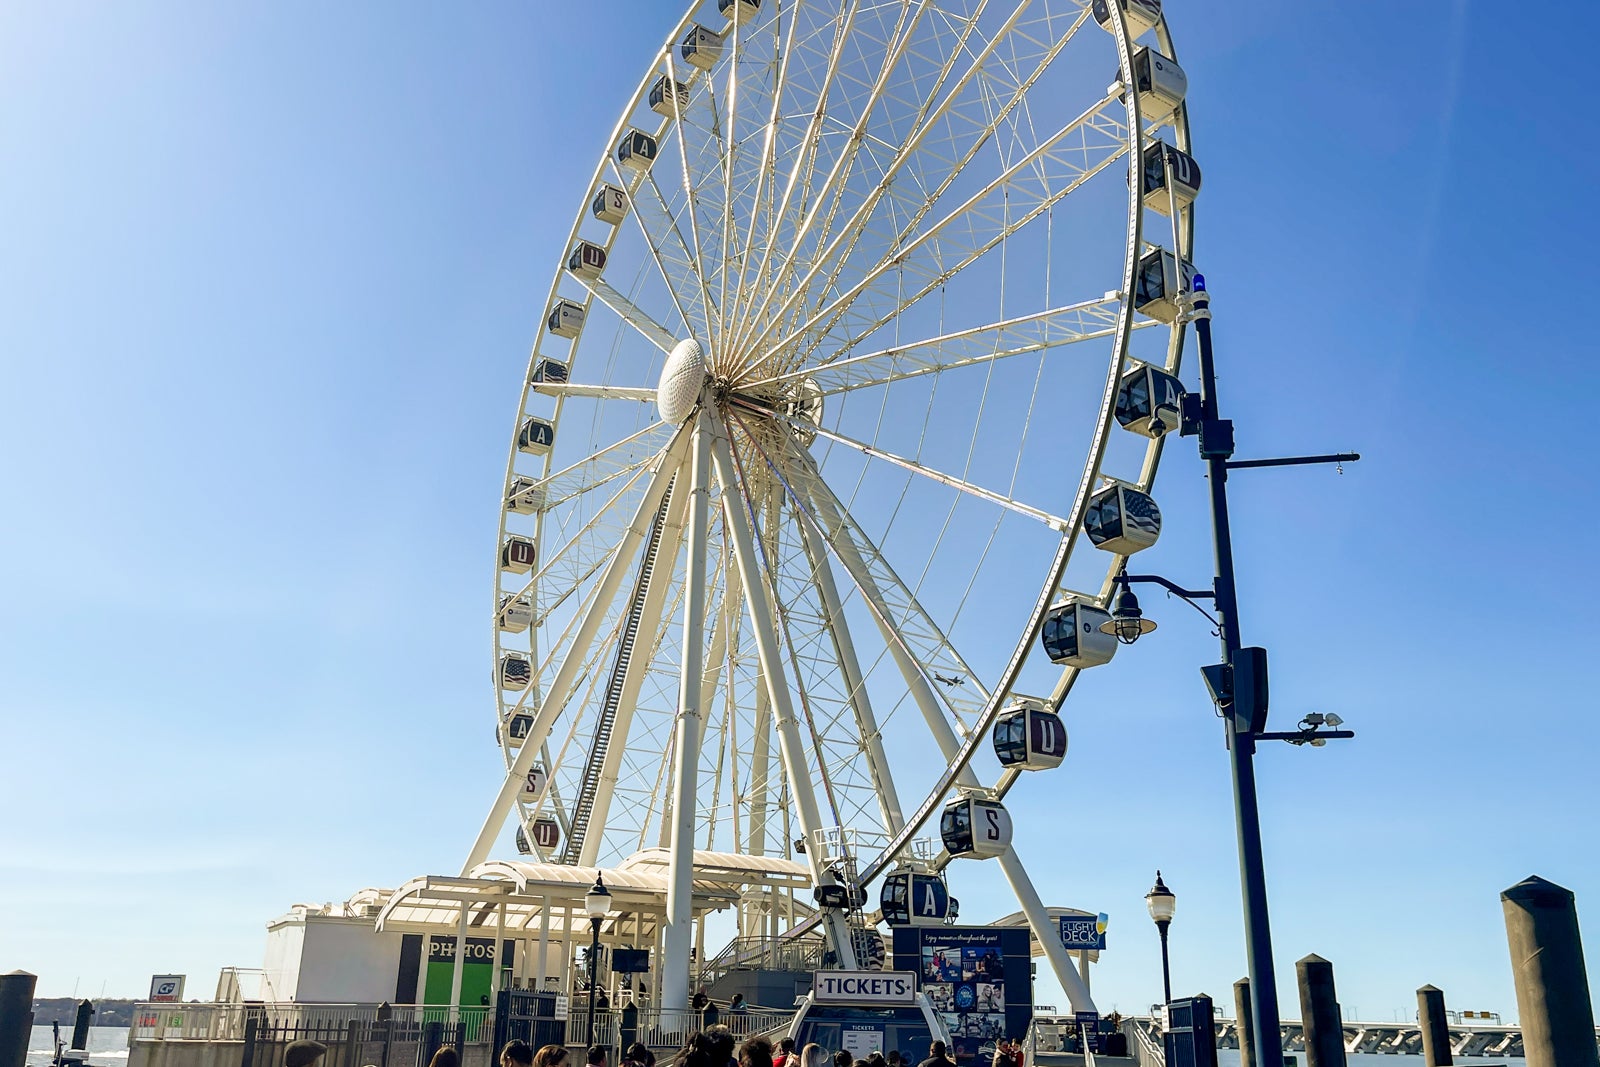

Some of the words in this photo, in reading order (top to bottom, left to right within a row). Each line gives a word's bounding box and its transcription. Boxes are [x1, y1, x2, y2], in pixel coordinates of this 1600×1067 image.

[640, 140, 648, 156] A
[1176, 152, 1190, 184] U
[537, 427, 546, 444] A
[518, 545, 527, 563] U
[517, 719, 527, 738] A
[1040, 719, 1055, 753] U
[526, 774, 536, 793] S
[985, 809, 1000, 841] S
[539, 824, 551, 845] U
[923, 883, 936, 916] A
[1062, 922, 1094, 931] FLIGHT
[1062, 930, 1096, 942] DECK
[429, 942, 496, 959] PHTOS
[824, 978, 906, 995] TICKETS
